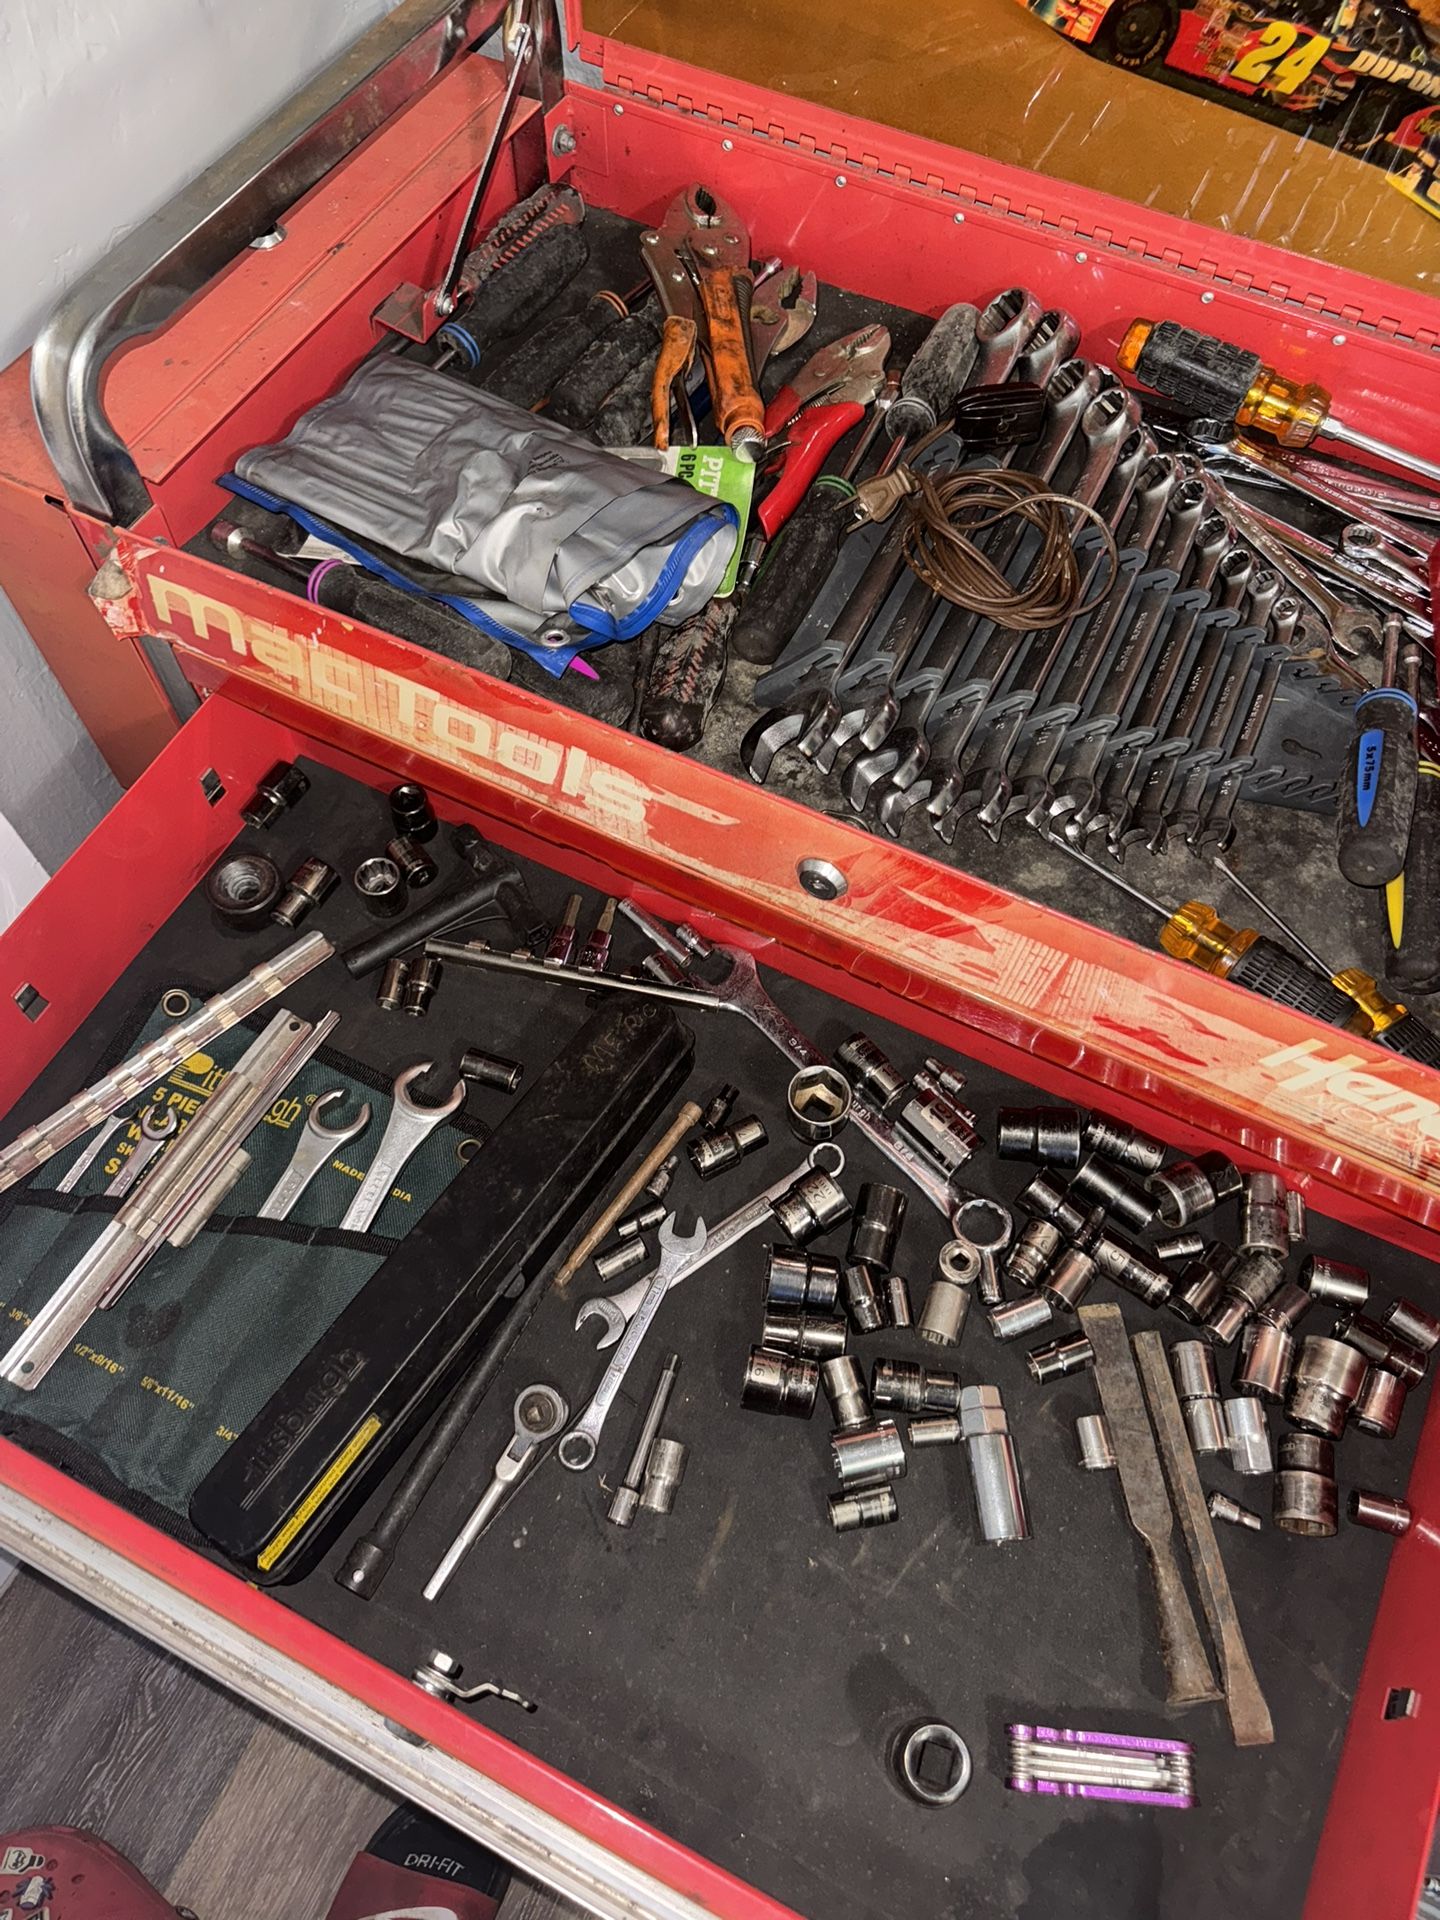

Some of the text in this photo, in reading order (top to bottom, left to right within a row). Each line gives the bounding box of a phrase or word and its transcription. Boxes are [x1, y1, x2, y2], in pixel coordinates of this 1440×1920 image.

[1230, 20, 1333, 95] 24
[680, 454, 697, 462] 6
[1362, 746, 1377, 791] 5x75mm
[152, 1087, 205, 1114] 5 PIE
[332, 1159, 413, 1202] MADE DIA
[73, 1343, 125, 1375] 1/2"x9/16"
[215, 1425, 239, 1442] 3/4"
[403, 1853, 464, 1876] DRI-FIT
